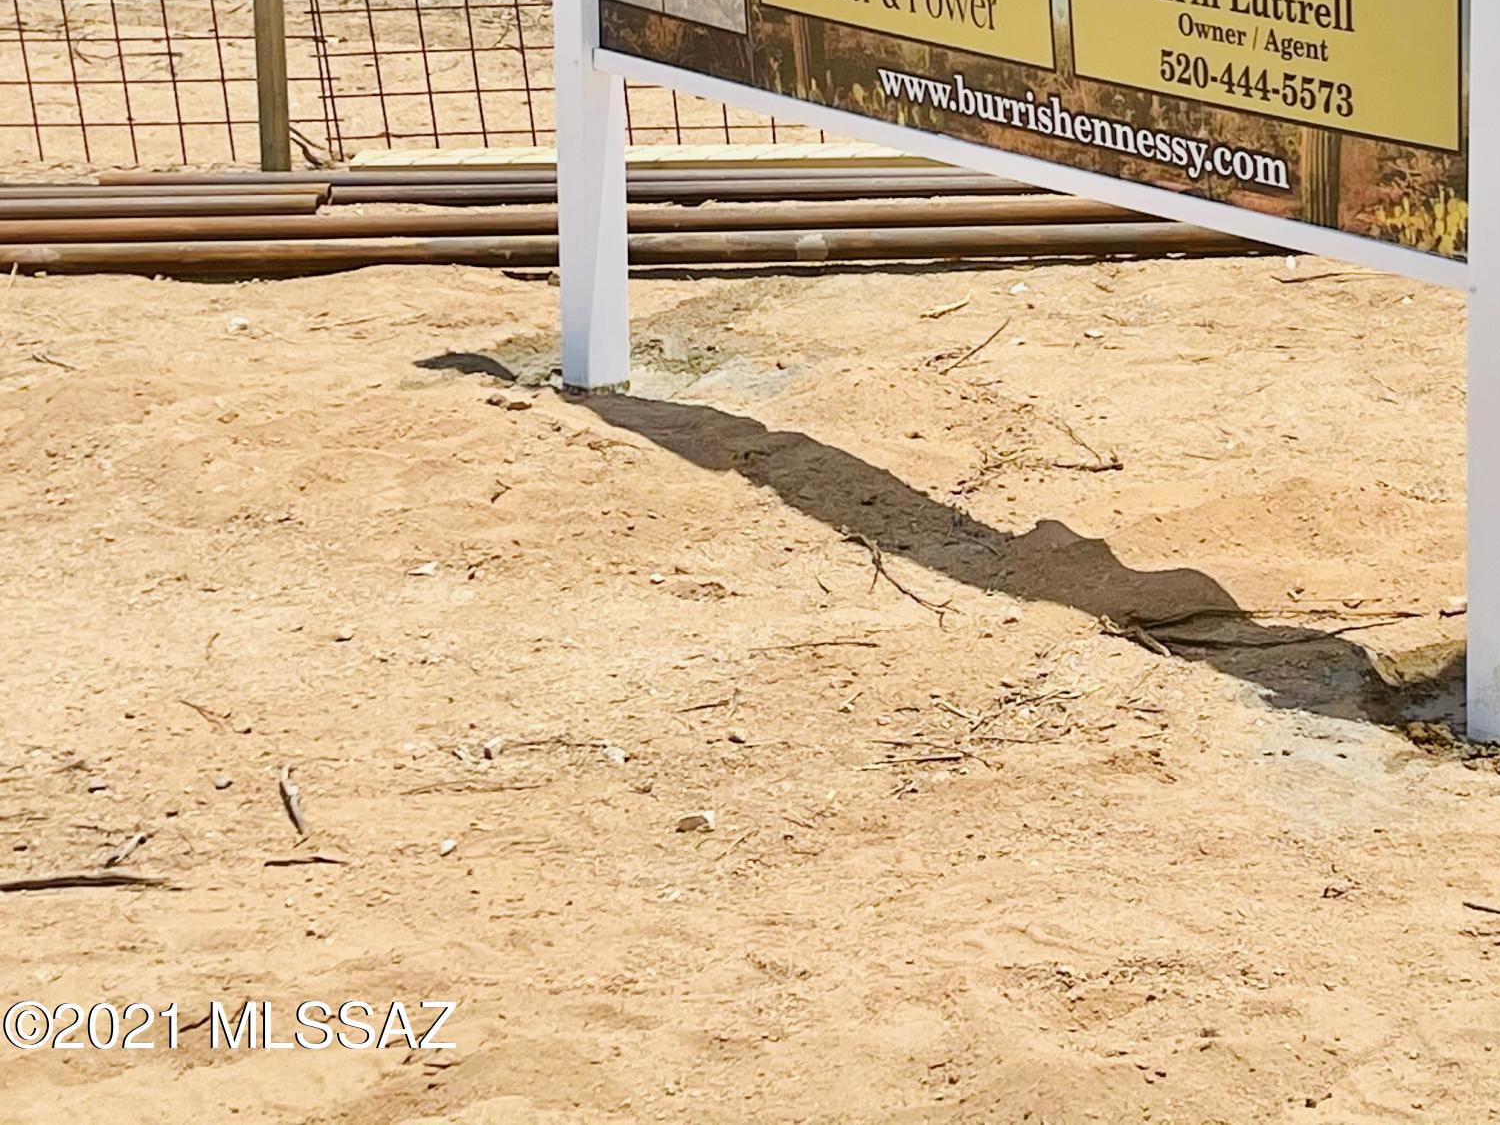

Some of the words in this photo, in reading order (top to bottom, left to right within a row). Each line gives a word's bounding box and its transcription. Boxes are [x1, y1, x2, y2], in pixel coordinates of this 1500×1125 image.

[1178, 12, 1247, 47] Owner
[1264, 28, 1329, 63] Agent
[1160, 49, 1354, 118] 520-444-5573
[877, 68, 1290, 190] www.burrishennessy.com
